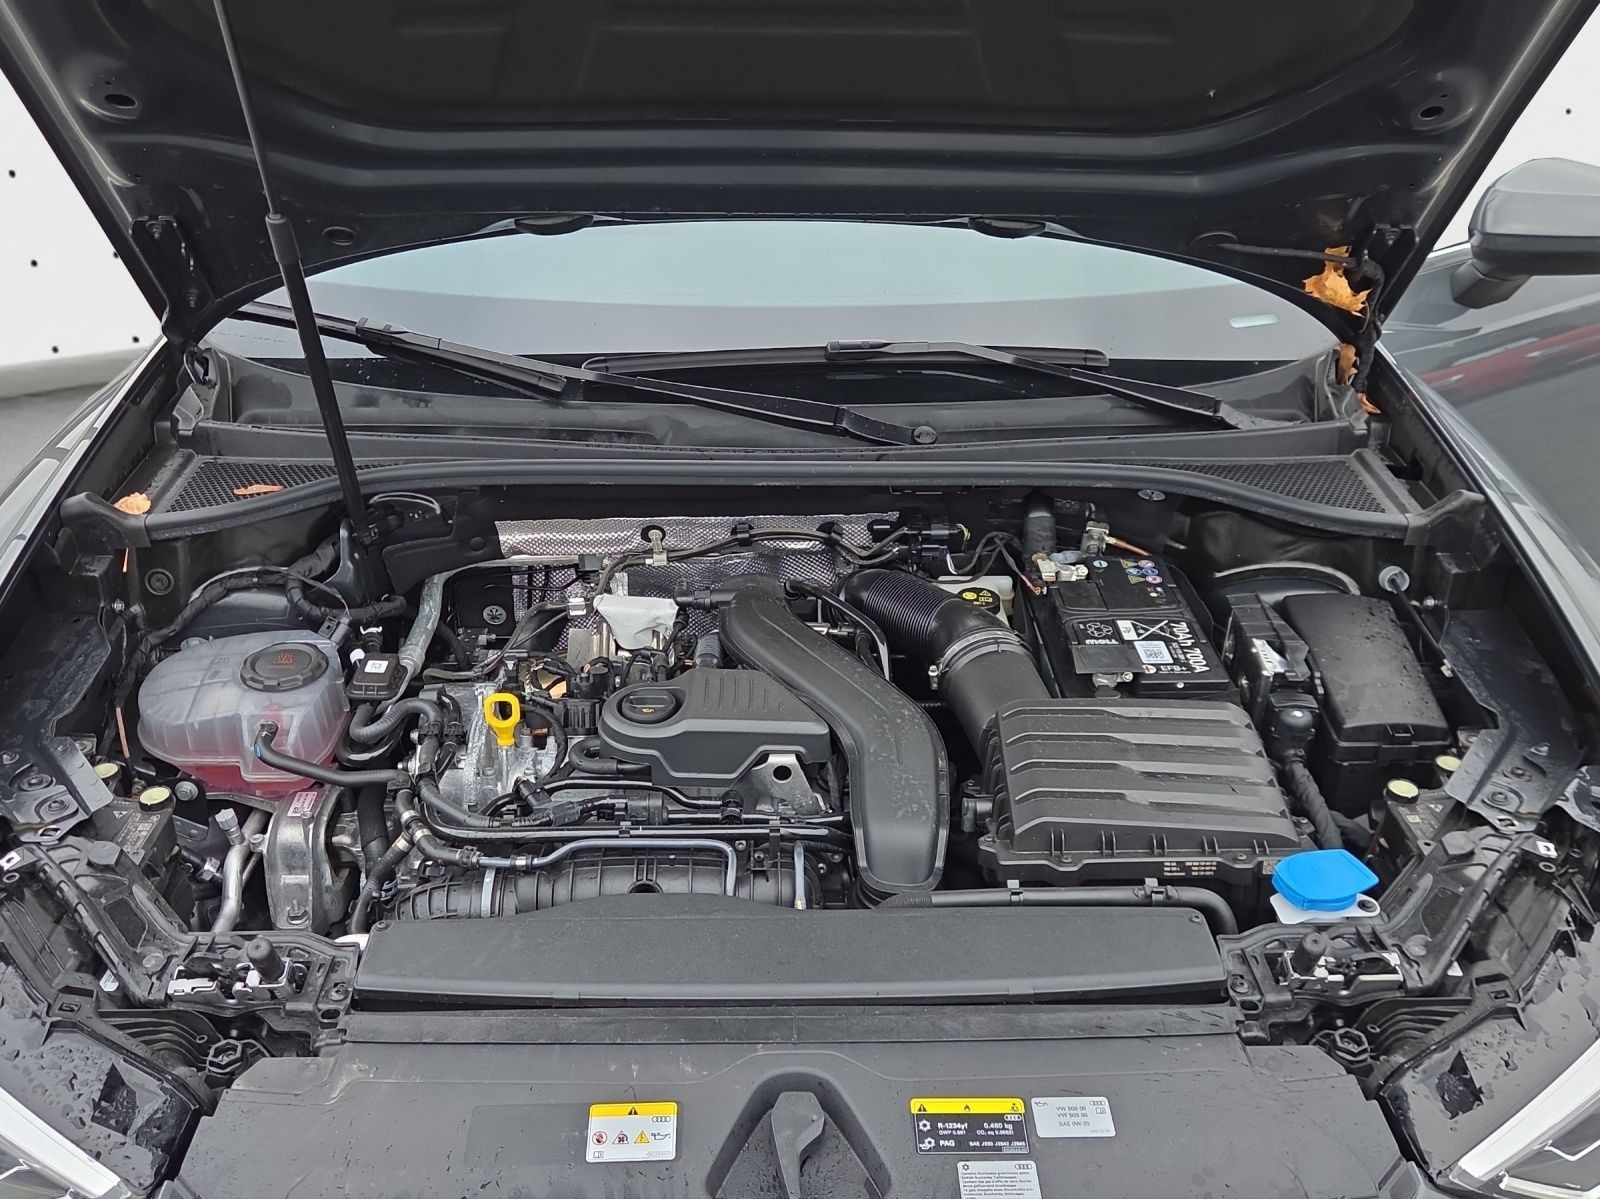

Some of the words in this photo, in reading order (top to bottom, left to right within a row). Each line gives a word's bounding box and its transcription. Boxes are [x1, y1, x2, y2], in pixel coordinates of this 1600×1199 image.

[1169, 622, 1196, 647] 70Ah
[1183, 647, 1210, 673] 700A
[937, 1122, 968, 1130] R-1234yf
[1004, 1122, 1013, 1130] kg
[939, 1139, 955, 1147] PAG
